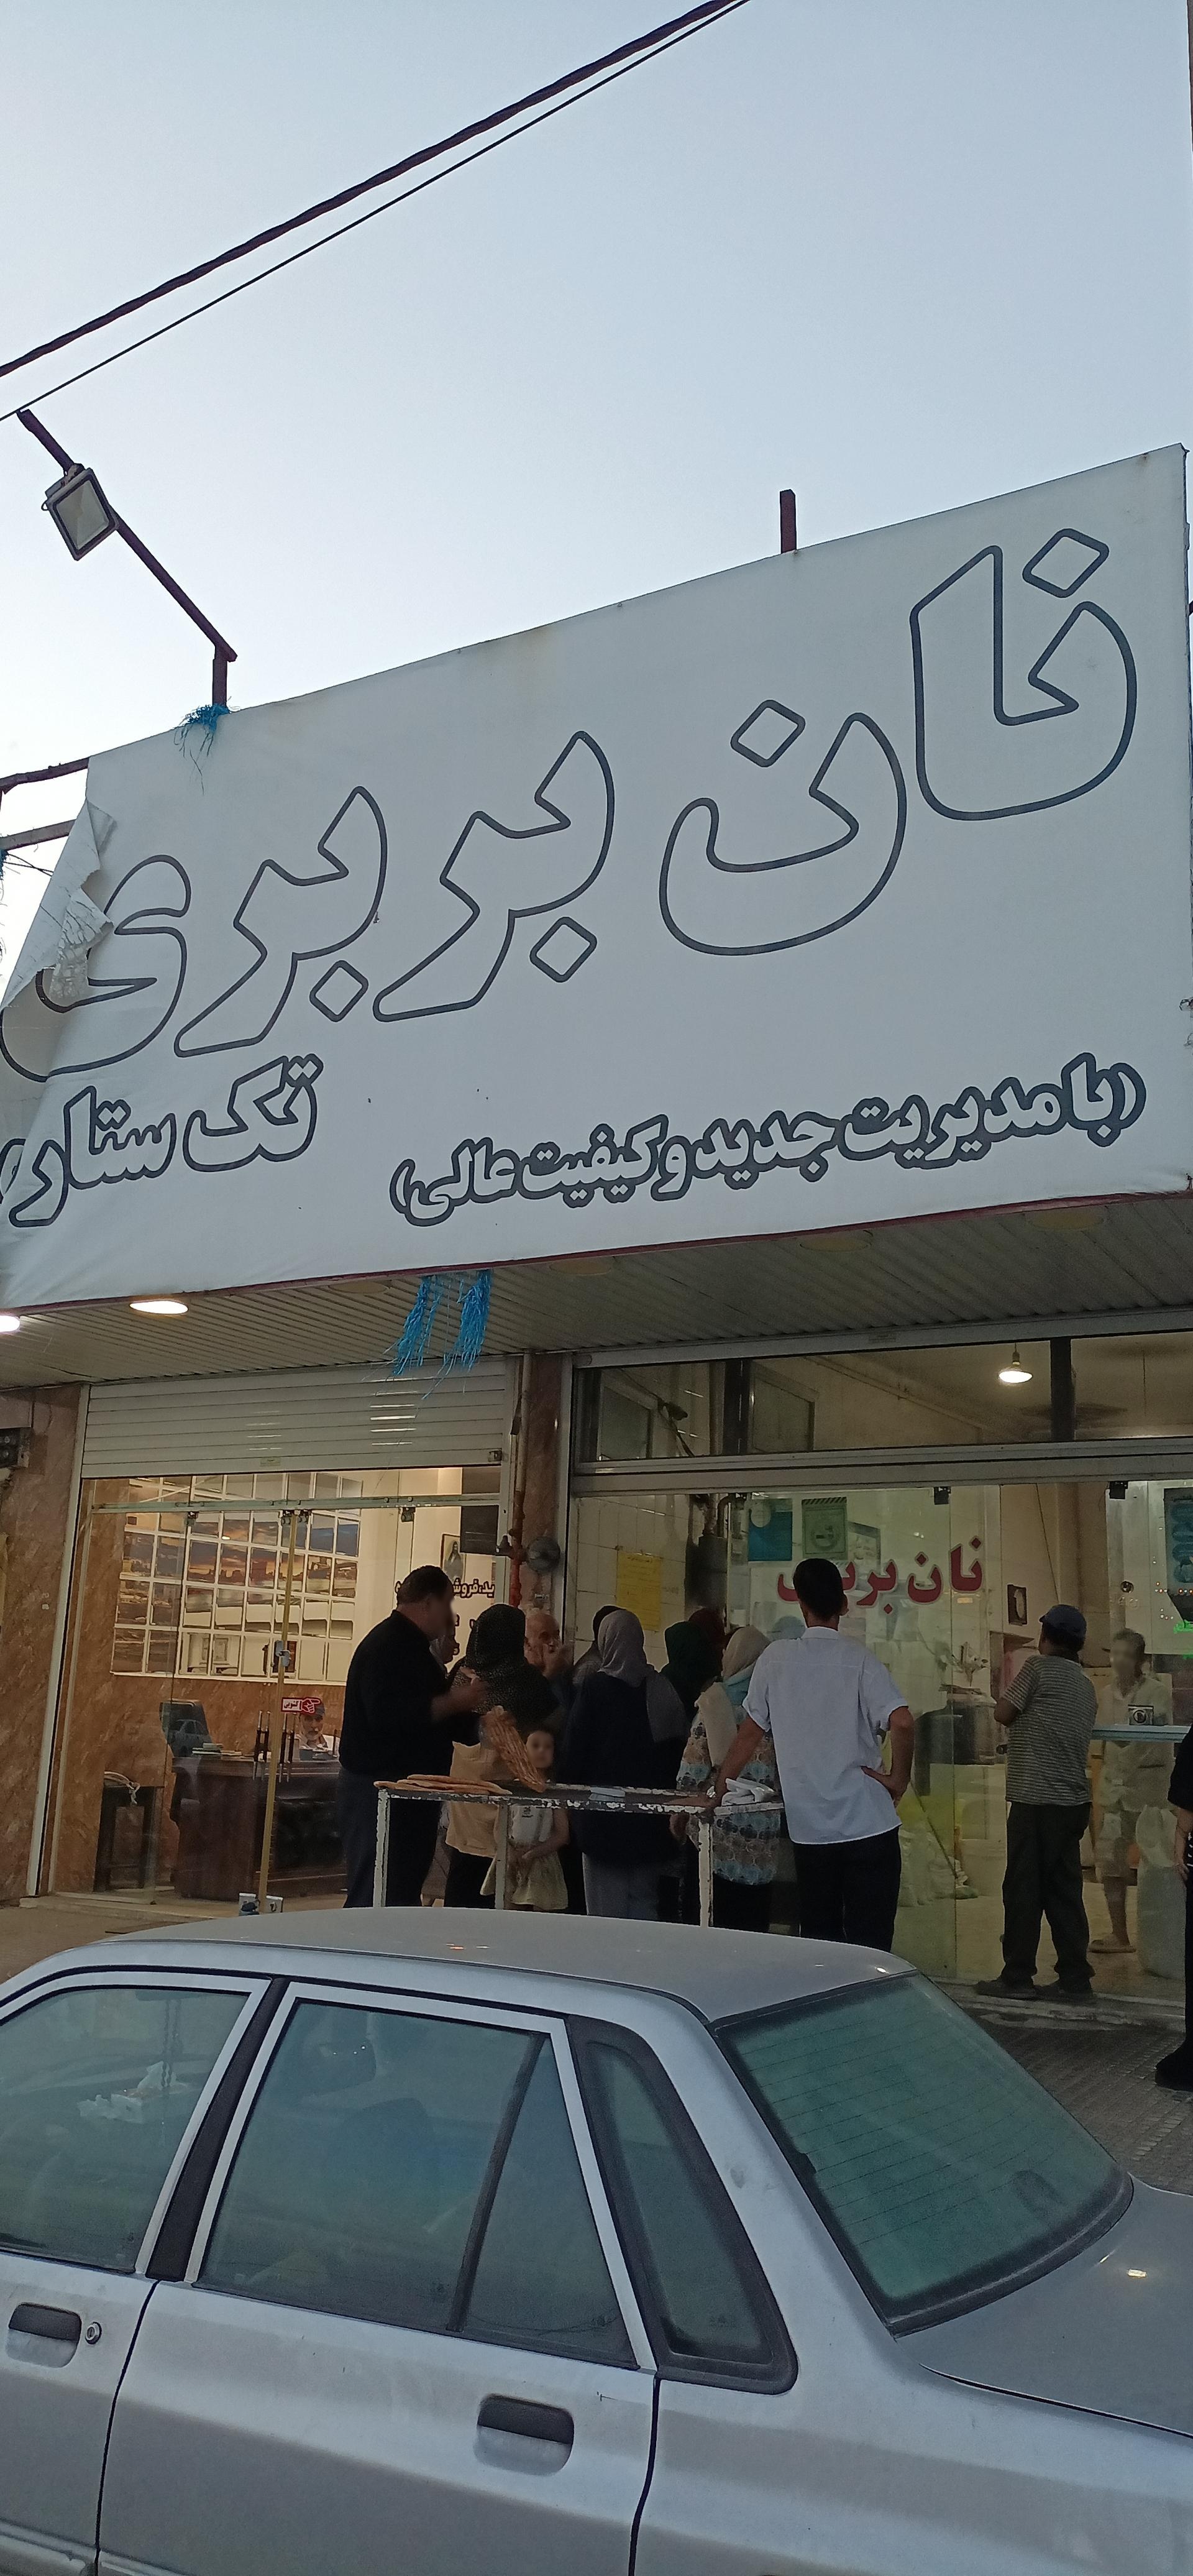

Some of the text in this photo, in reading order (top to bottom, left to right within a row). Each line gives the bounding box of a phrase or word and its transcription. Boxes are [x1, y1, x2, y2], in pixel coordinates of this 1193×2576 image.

[0, 528, 1136, 1082] نان بربری
[182, 1053, 323, 1173] تک
[691, 1110, 839, 1190] جدید
[837, 1077, 1063, 1170] مدیریت
[518, 1114, 669, 1209] کیفیت
[651, 1135, 693, 1201] و
[906, 1535, 984, 1605] نان
